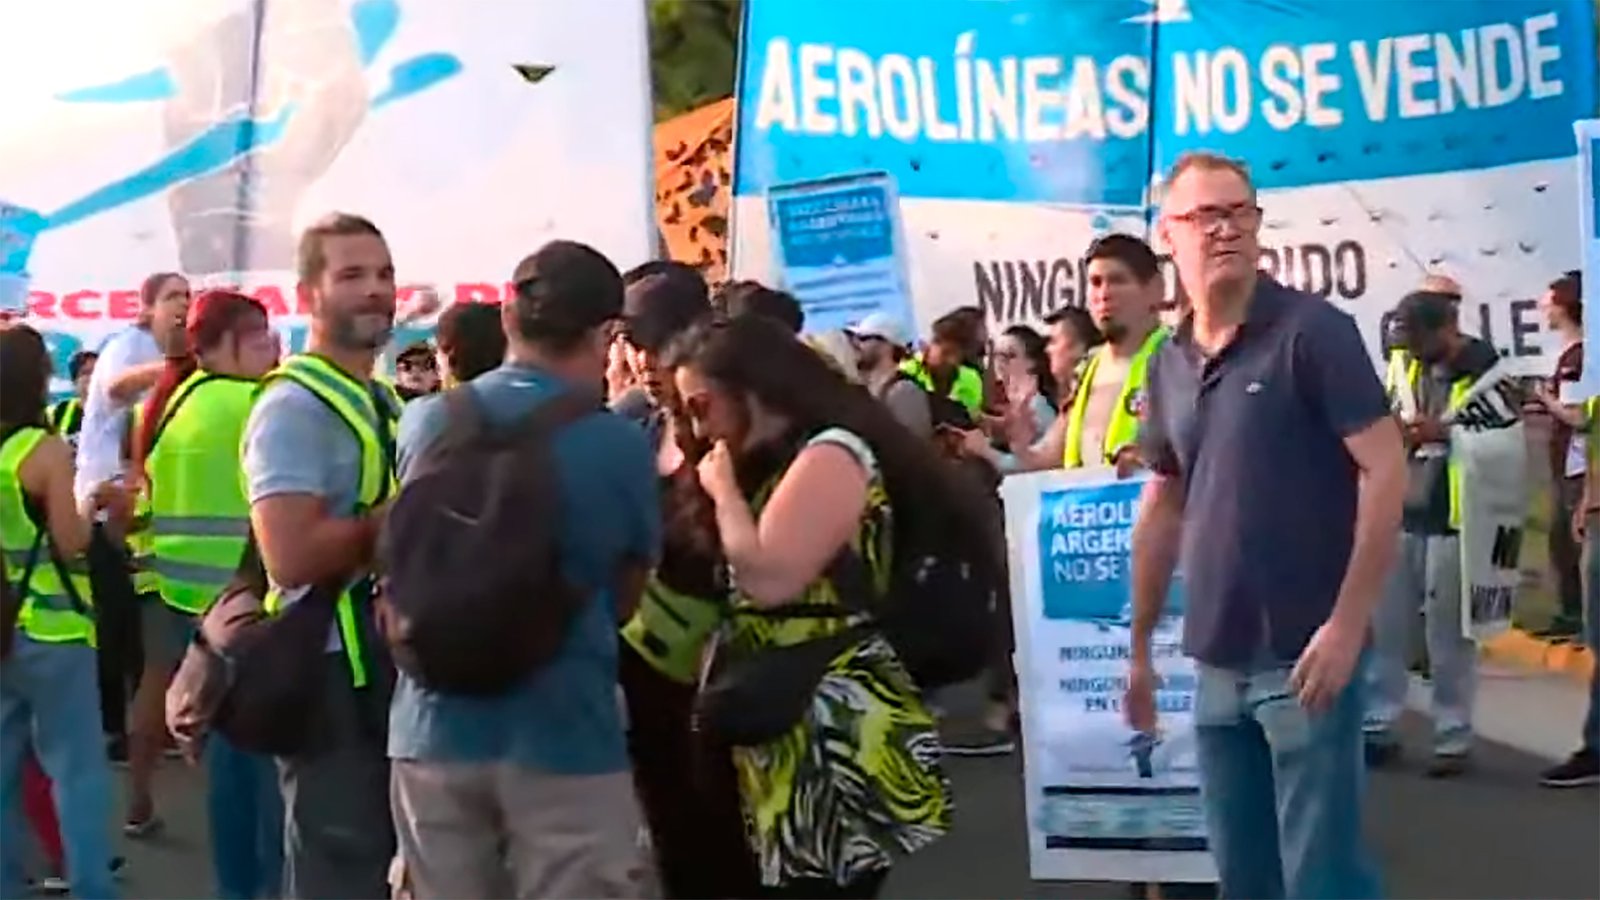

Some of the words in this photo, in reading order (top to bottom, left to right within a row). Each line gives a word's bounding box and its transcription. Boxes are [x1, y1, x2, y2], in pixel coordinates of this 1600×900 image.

[755, 30, 1149, 143] AEROLÍNEAS
[1173, 46, 1251, 136] NO
[1260, 42, 1342, 130] SE
[1349, 12, 1564, 122] VENDE
[1051, 528, 1132, 556] ARGEN
[1053, 557, 1089, 582] NO
[1095, 556, 1121, 581] SE
